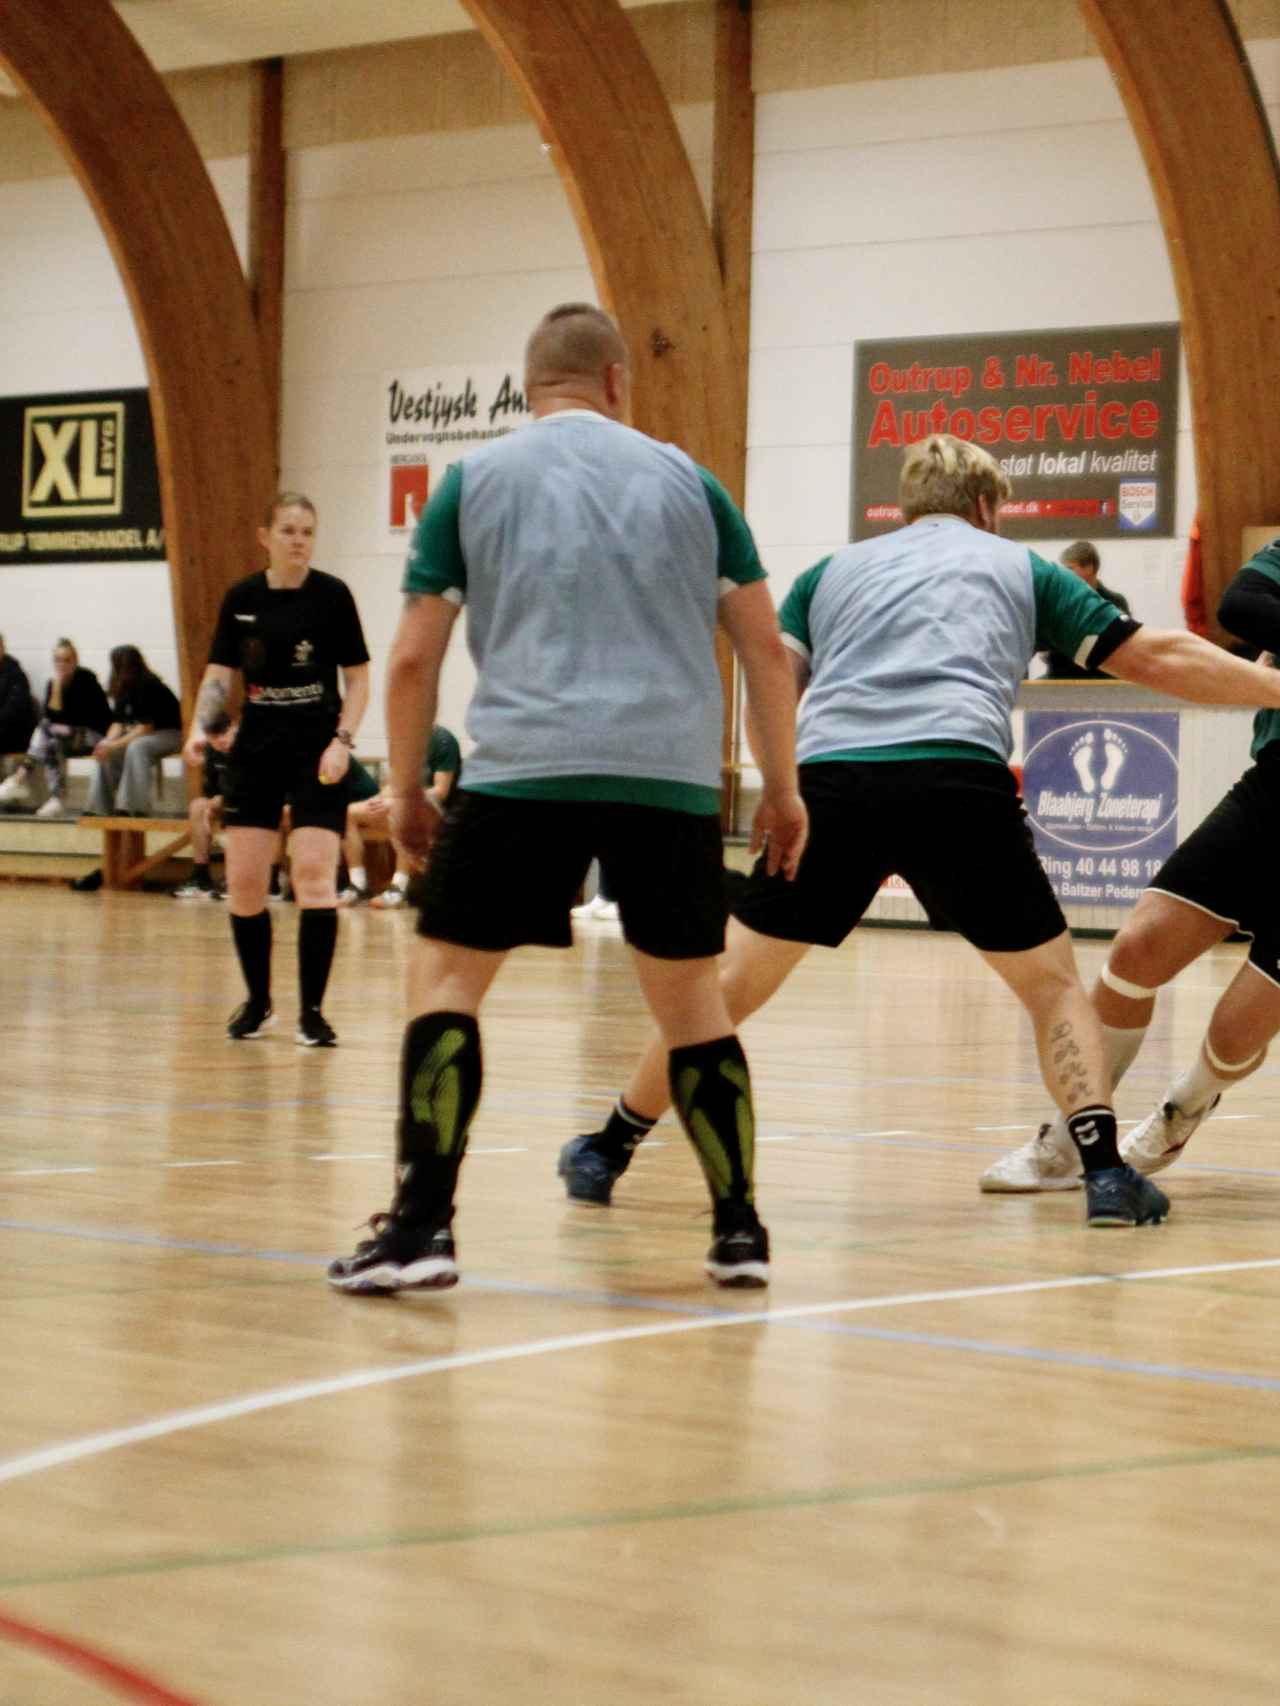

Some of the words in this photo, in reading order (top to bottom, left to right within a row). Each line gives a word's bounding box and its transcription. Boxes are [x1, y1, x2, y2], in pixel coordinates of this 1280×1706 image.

[868, 362, 972, 398] Outrup
[982, 355, 1004, 389] &
[1016, 354, 1057, 387] Nr.
[1070, 351, 1161, 385] Nebel
[388, 378, 478, 429] Vestjysk
[866, 391, 1161, 448] Autoservice
[31, 420, 114, 501] XL
[1037, 451, 1086, 475] lokal
[1089, 450, 1158, 474] kvalitet
[1037, 855, 1072, 878] Ring
[1076, 857, 1094, 875] 40
[1098, 858, 1117, 876] 44
[1121, 859, 1139, 876] 98
[1105, 884, 1142, 899] Peder
